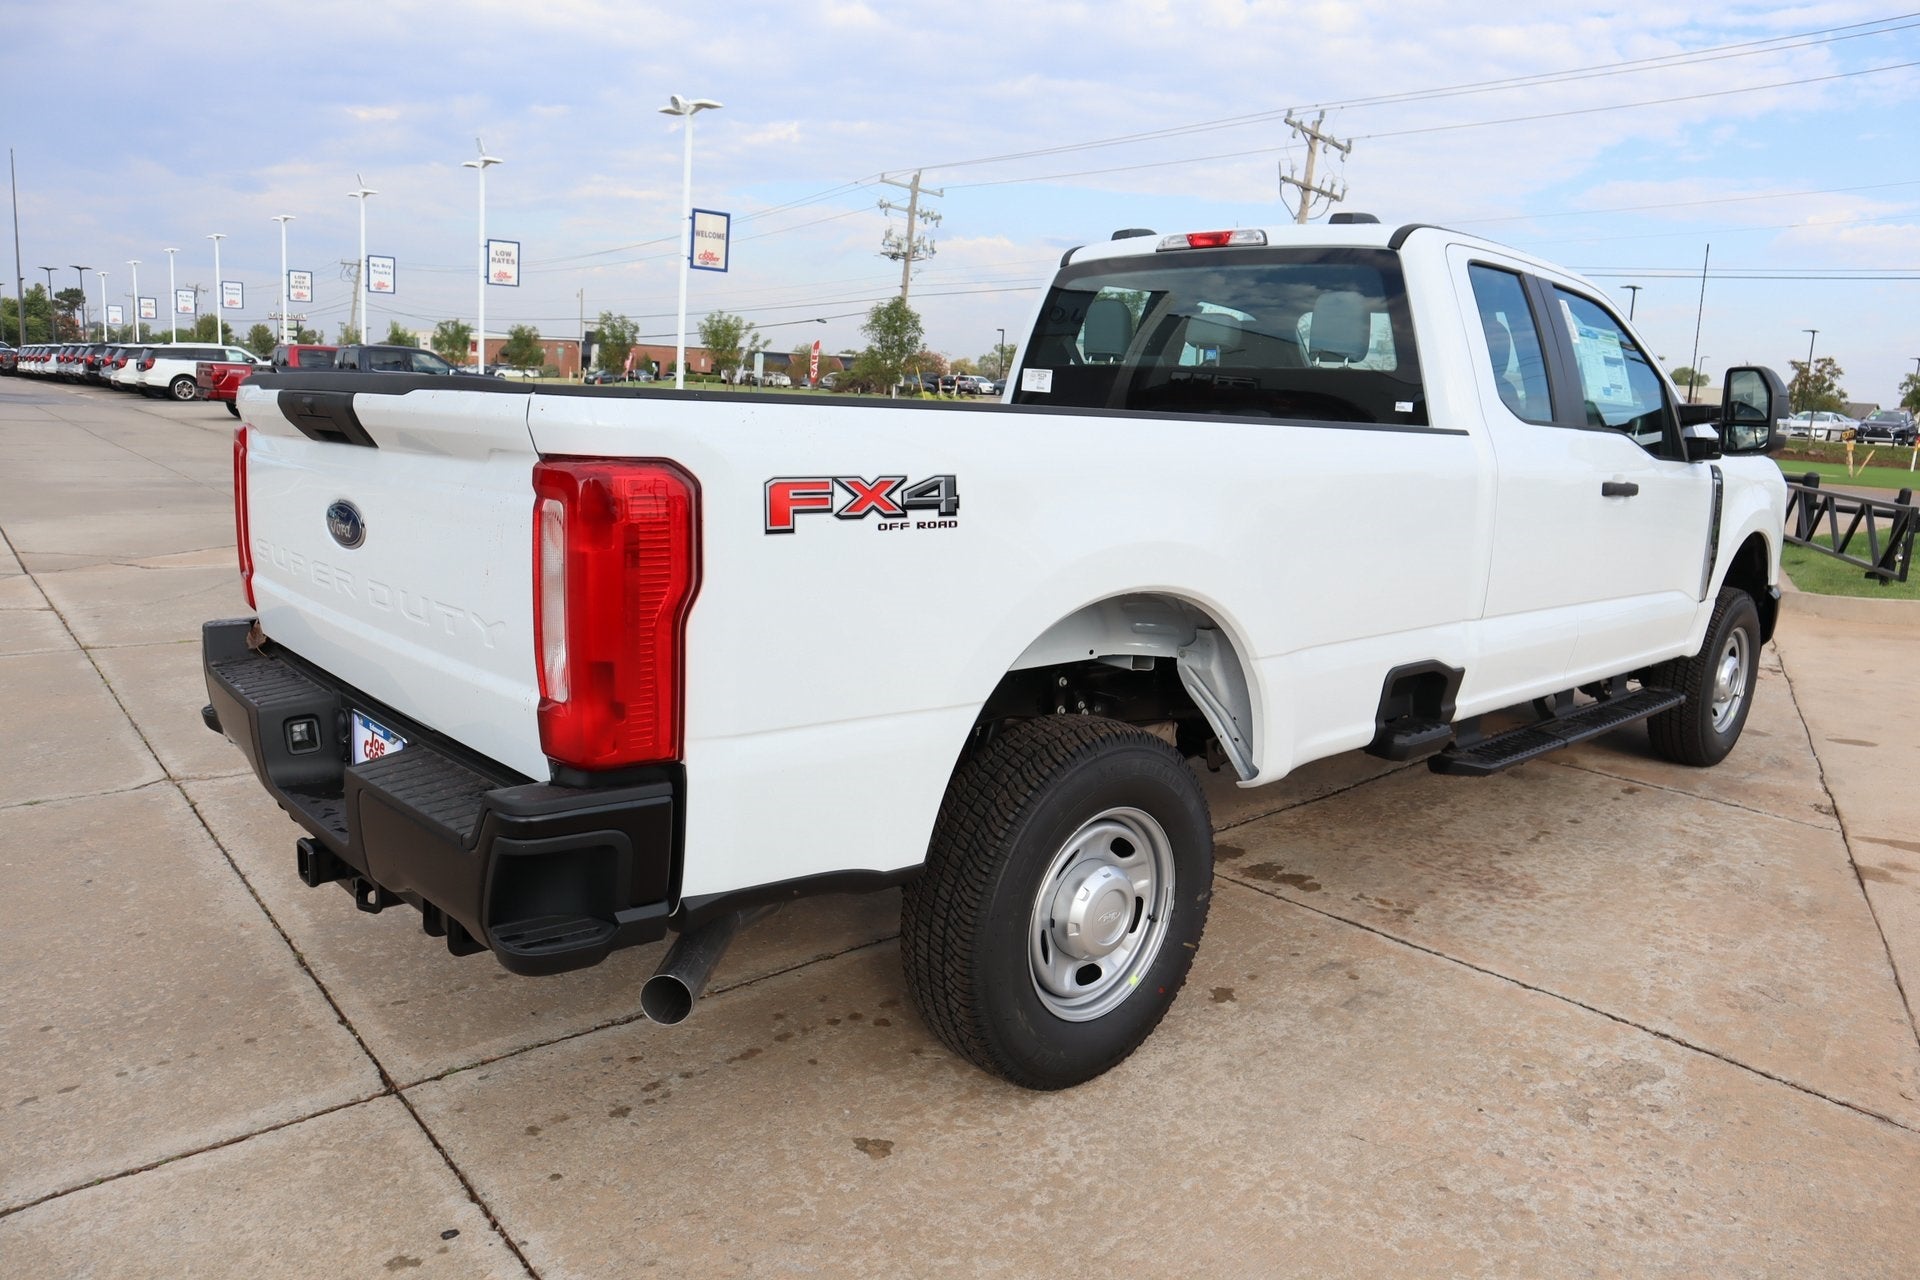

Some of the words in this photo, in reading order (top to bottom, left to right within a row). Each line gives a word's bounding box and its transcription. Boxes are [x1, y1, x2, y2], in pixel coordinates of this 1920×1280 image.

[695, 230, 726, 240] WELCOME
[491, 257, 516, 265] RATES
[810, 349, 819, 378] SALE
[763, 474, 960, 535] FX4
[877, 522, 910, 532] OFF
[916, 520, 958, 531] ROAD
[254, 538, 359, 600] SUPER
[367, 578, 506, 649] DUTY
[369, 732, 385, 755] Joe
